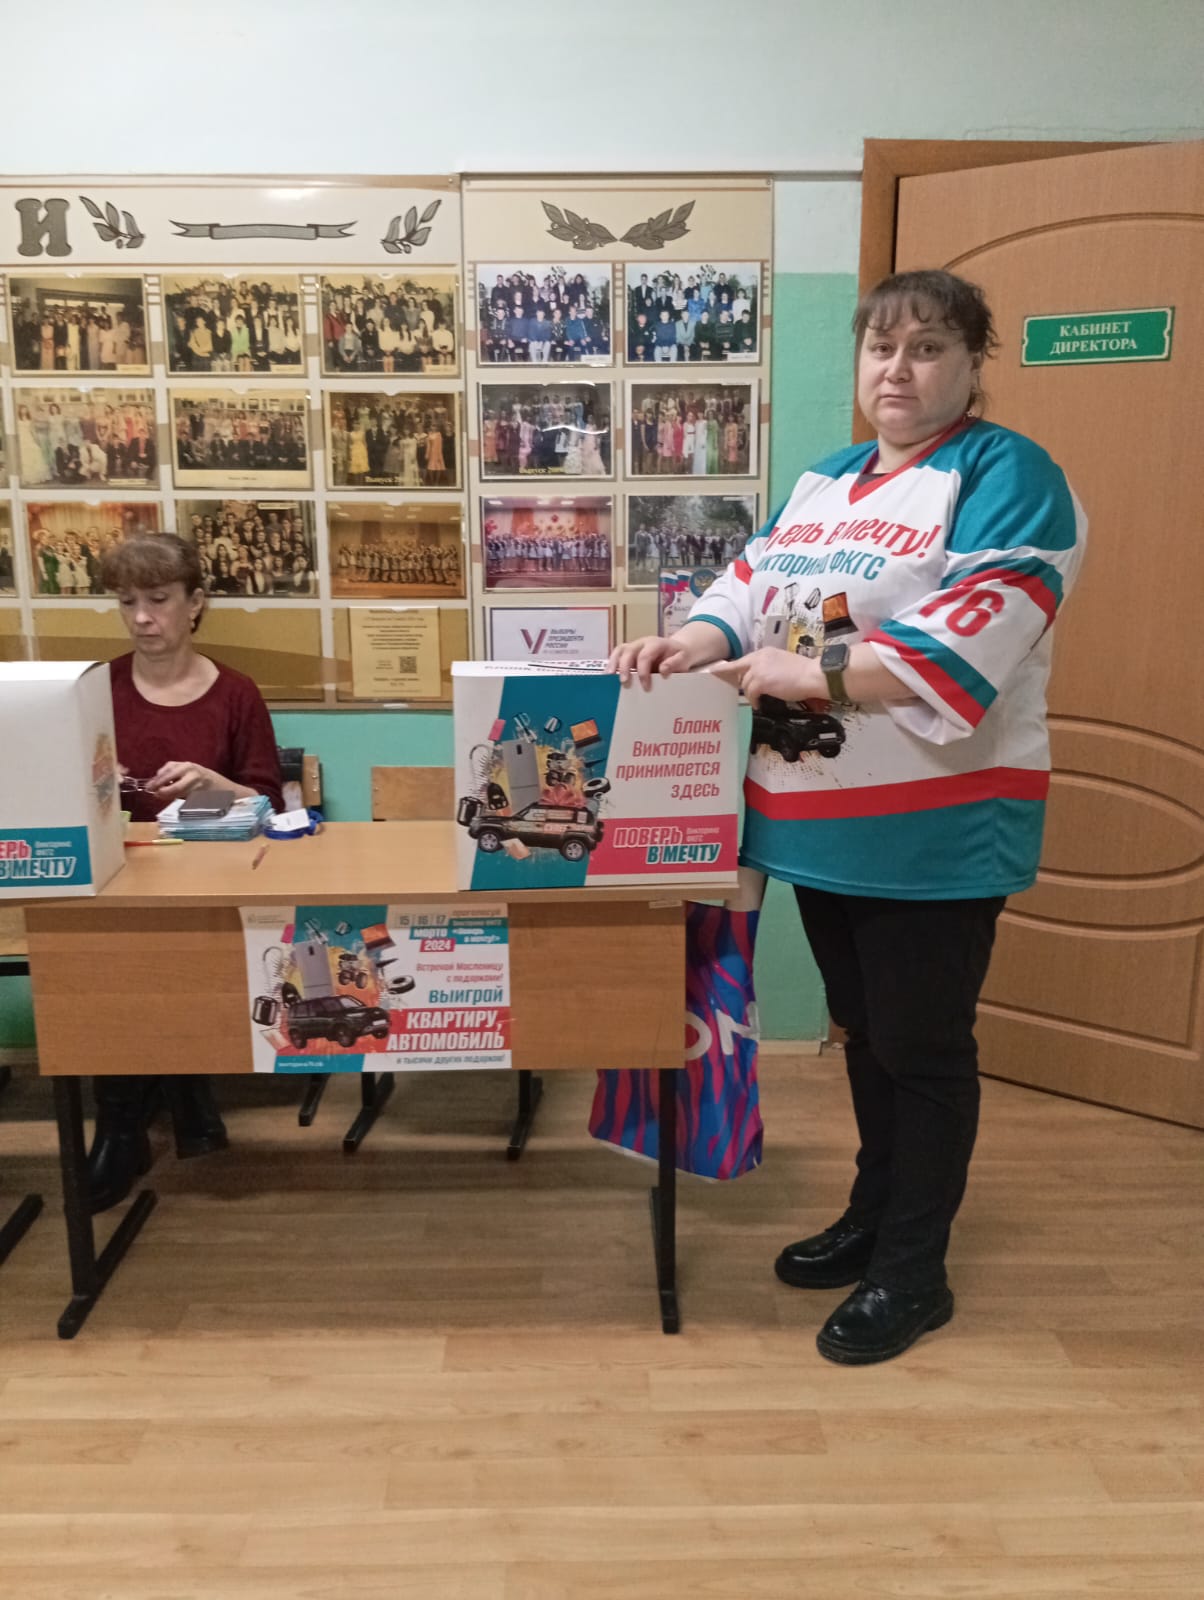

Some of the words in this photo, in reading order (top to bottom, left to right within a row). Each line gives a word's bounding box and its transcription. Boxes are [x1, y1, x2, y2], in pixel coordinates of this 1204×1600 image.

[14, 197, 72, 257] И
[1060, 321, 1132, 337] КАБИНЕТ
[1049, 338, 1138, 355] ДИРЕКТОРА
[829, 549, 887, 581] ФКГС
[918, 584, 1005, 637] 76
[632, 740, 721, 758] Викторины
[616, 761, 721, 781] принимается
[671, 783, 720, 800] здесь
[613, 826, 684, 848] ПОВЕРЬ
[661, 843, 722, 864] МЕЧТУ
[10, 856, 77, 879] МЕЧТУ
[400, 915, 410, 926] 15
[424, 940, 452, 951] 2024
[428, 986, 503, 1005] выиграй
[406, 1010, 503, 1031] КВАРТИРУ,
[385, 1031, 505, 1052] АВТОМОБИЛЬ
